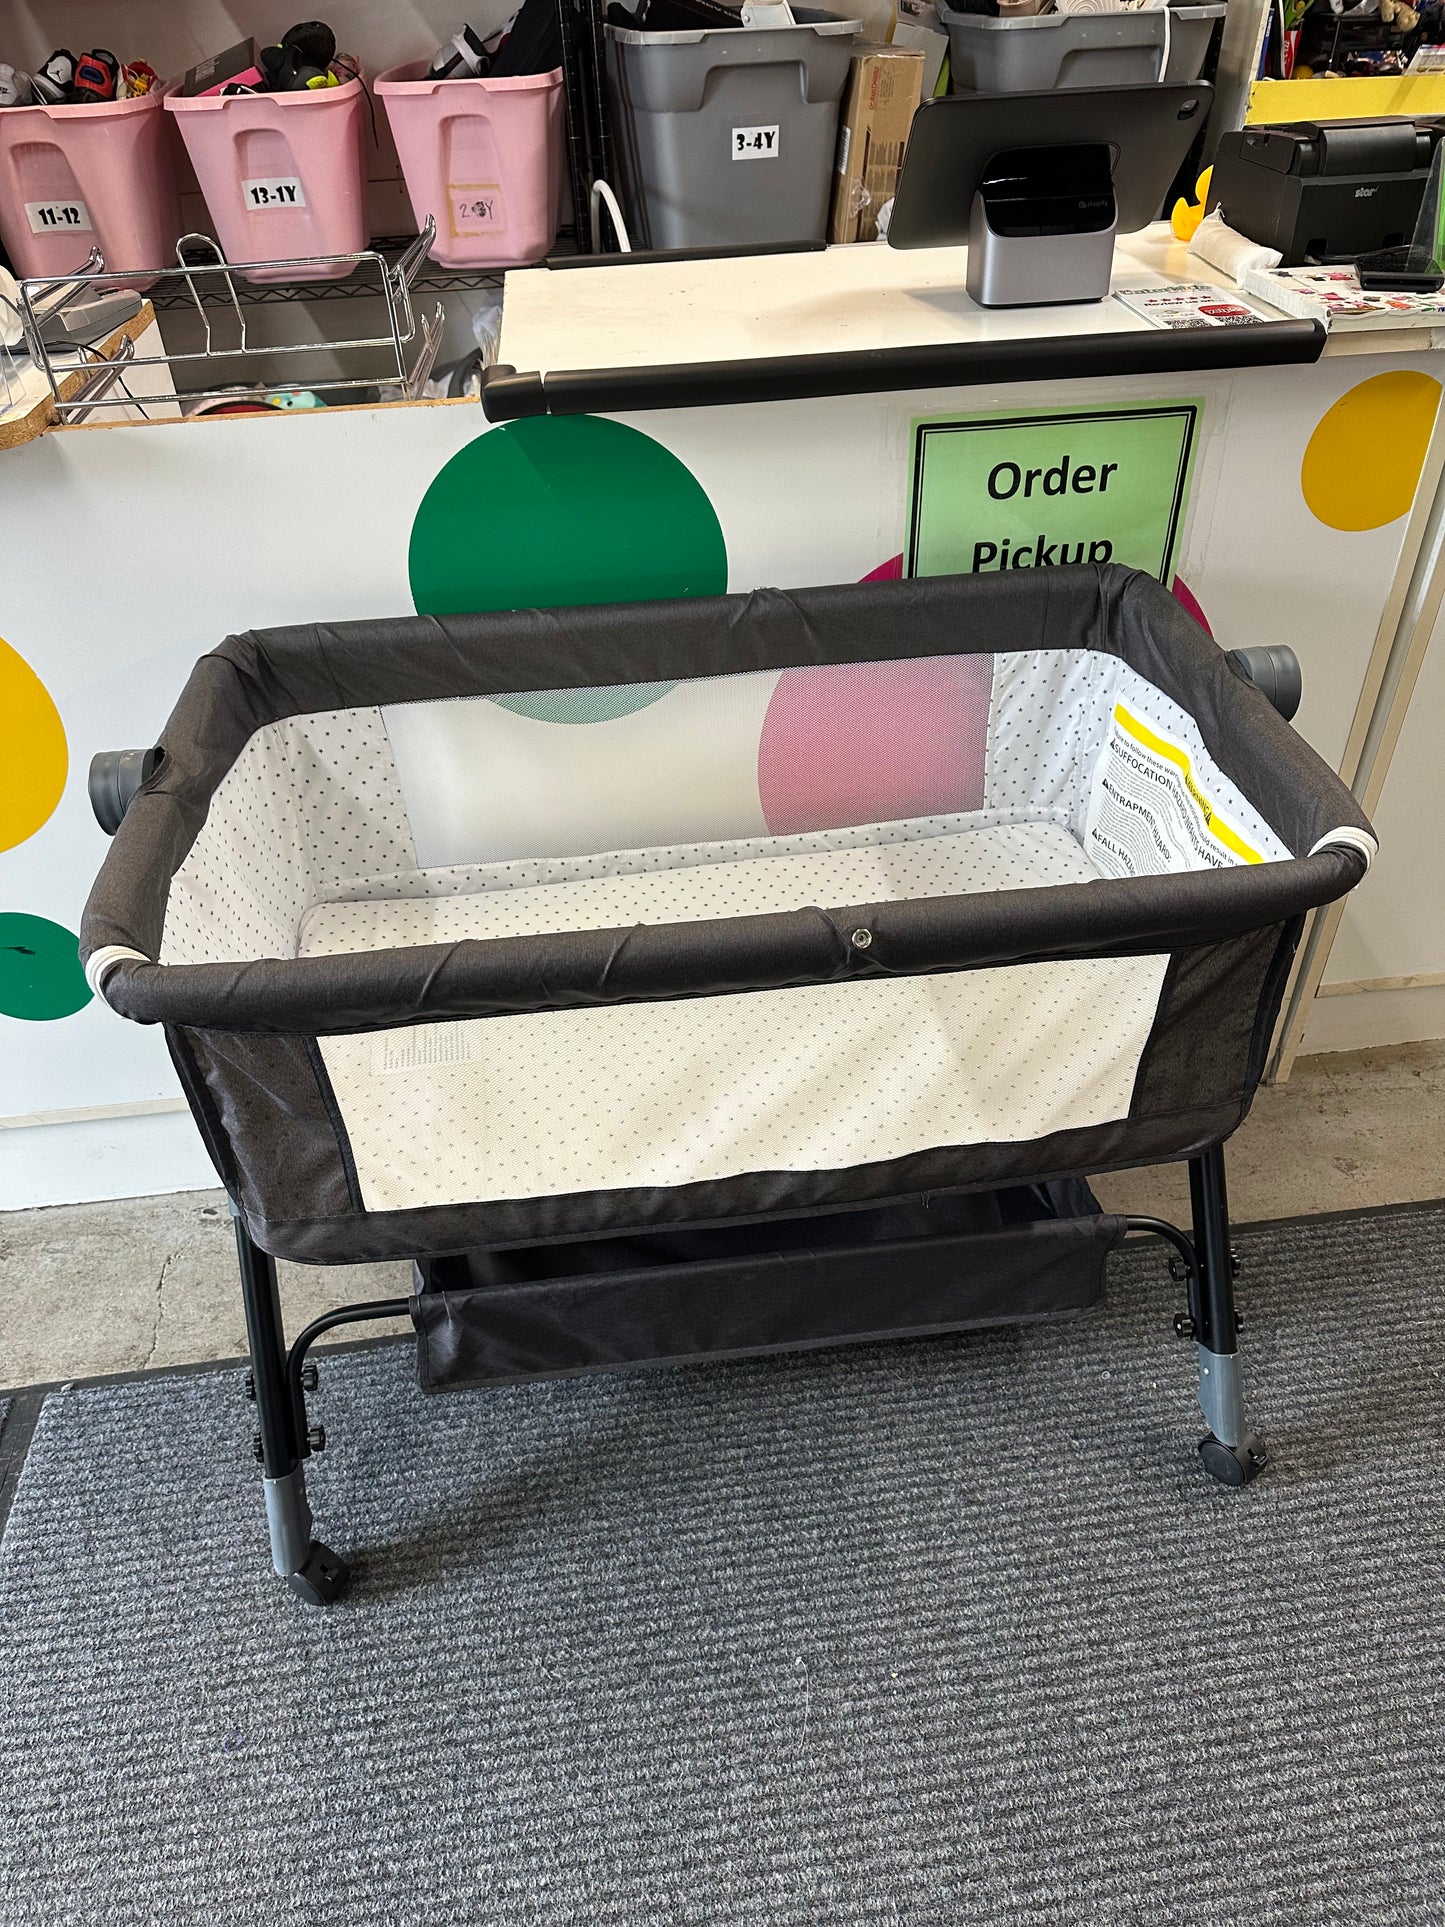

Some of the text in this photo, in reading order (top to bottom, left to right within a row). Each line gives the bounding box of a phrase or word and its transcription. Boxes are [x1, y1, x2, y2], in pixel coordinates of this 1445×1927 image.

[736, 131, 776, 151] 3-4Y
[250, 185, 296, 204] 13-1Y
[38, 207, 81, 225] 11-12
[987, 455, 1118, 500] Order
[972, 534, 1113, 574] Pickup
[1114, 743, 1174, 791] SUFFOCATION
[1108, 783, 1156, 829] ENTRAPMENT
[1096, 833, 1117, 854] FALL
